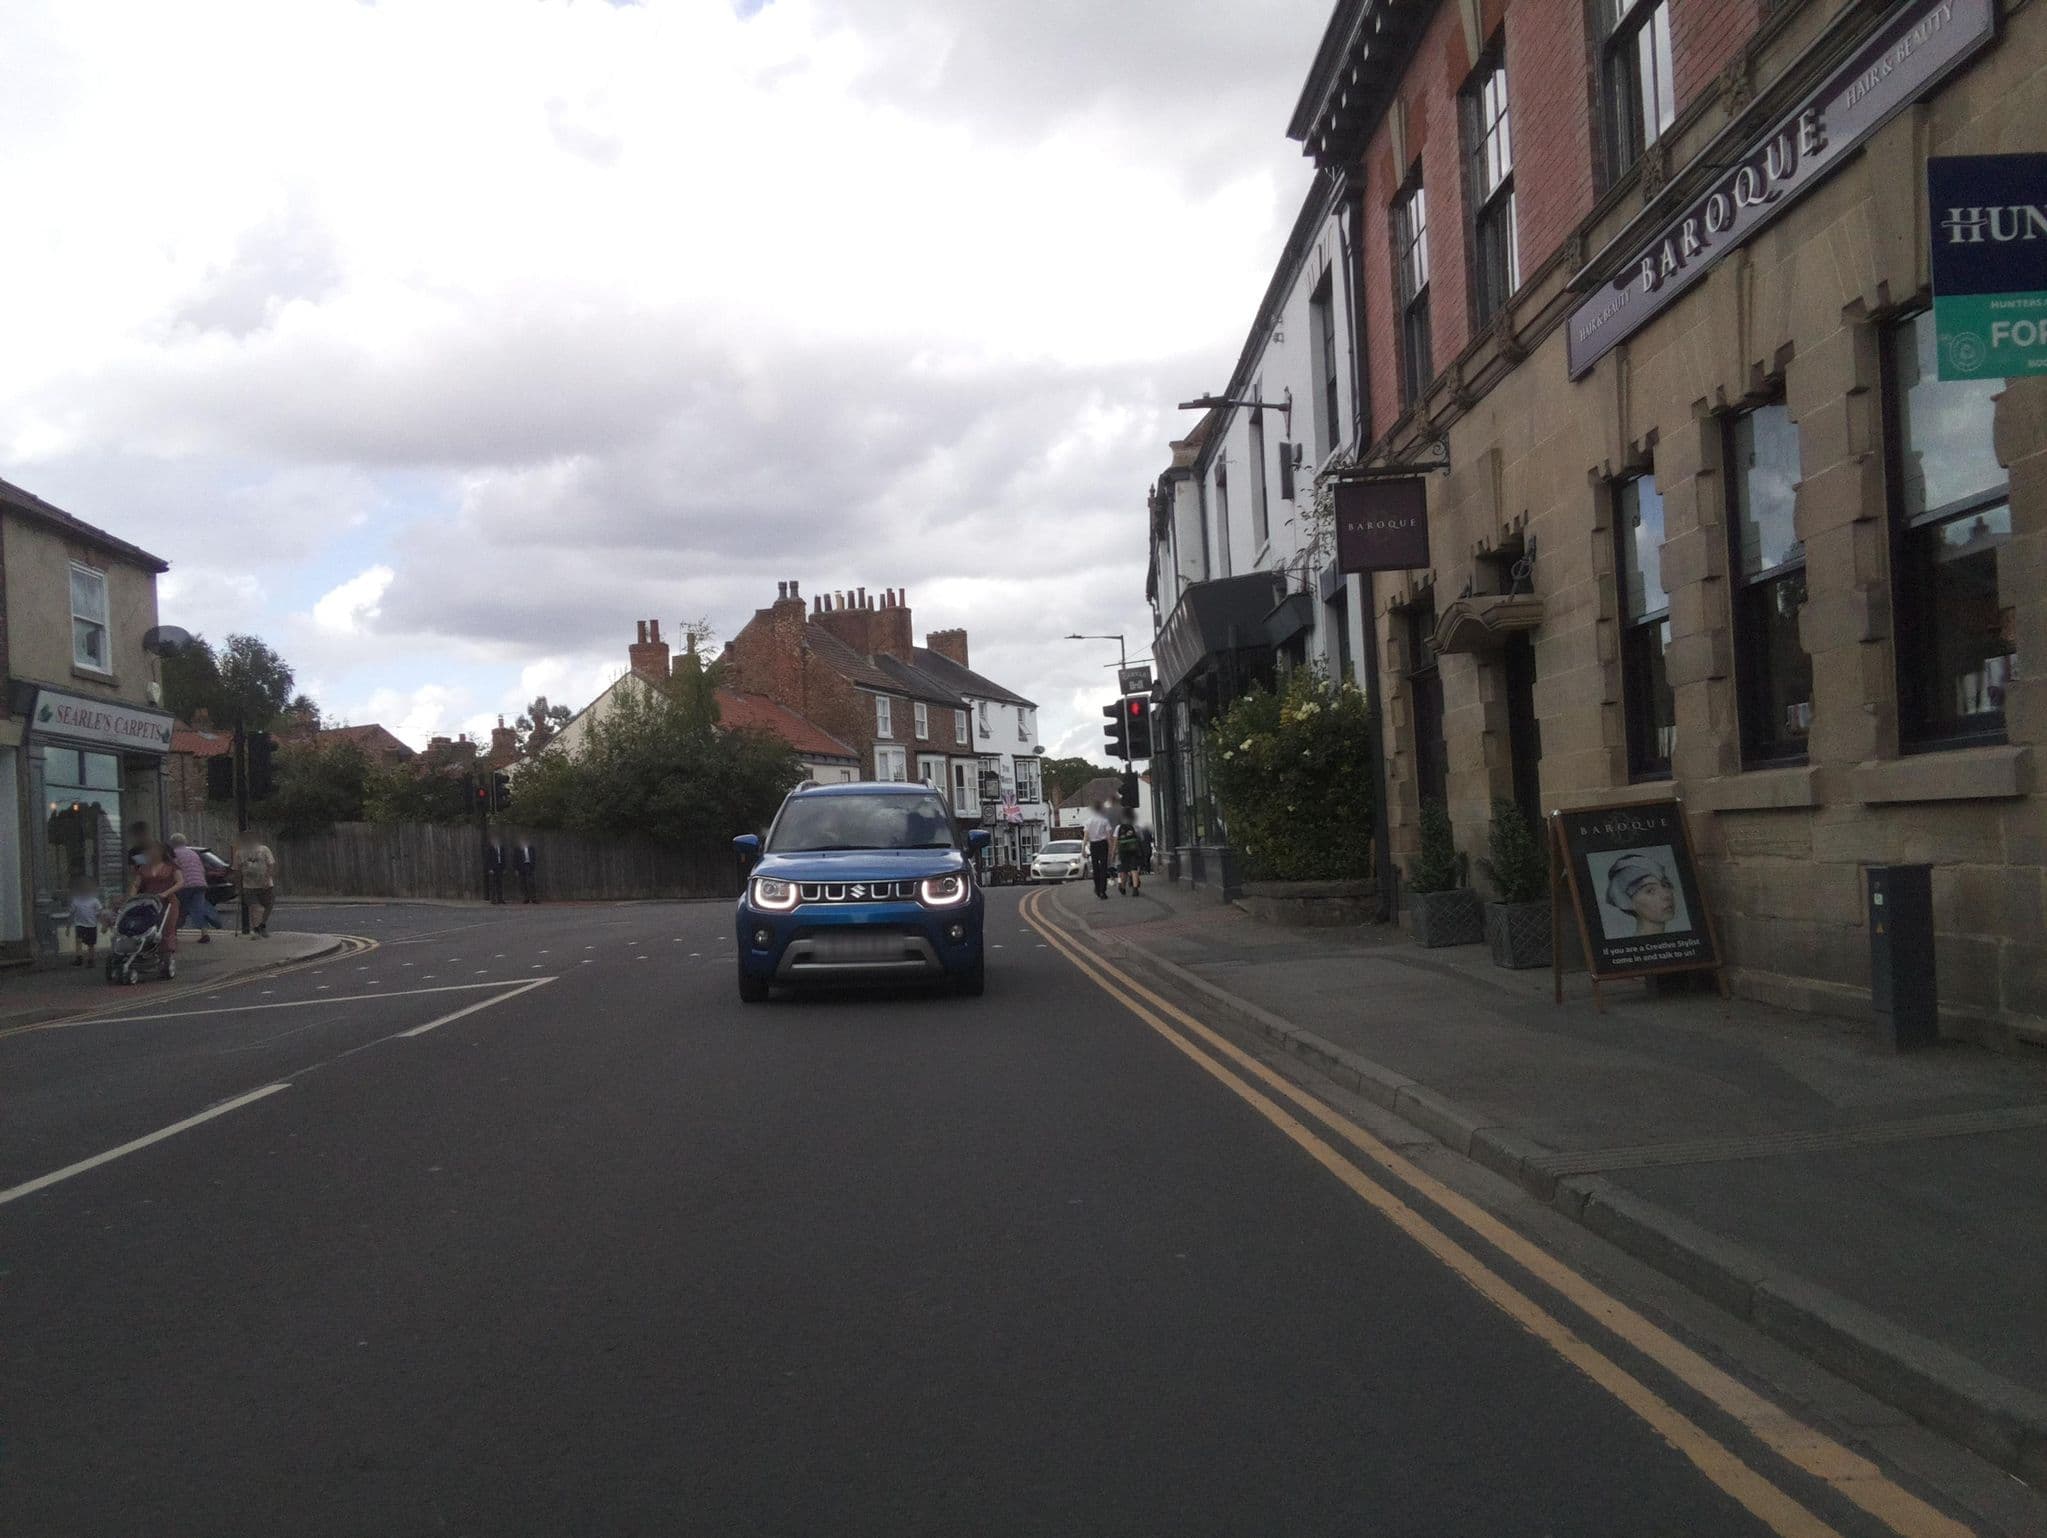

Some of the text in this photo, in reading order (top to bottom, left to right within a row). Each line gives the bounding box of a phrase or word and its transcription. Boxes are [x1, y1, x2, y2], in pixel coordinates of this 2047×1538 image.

[1846, 1, 1953, 110] HAIR & BEAUTY
[1641, 107, 1818, 293] BAROQUE
[1991, 298, 2041, 309] HUNTERS
[1348, 518, 1416, 531] BAROQUE
[57, 704, 161, 739] SEARLE'S CARPETS
[1580, 818, 1667, 836] BAROQUE
[1610, 948, 1624, 956] you
